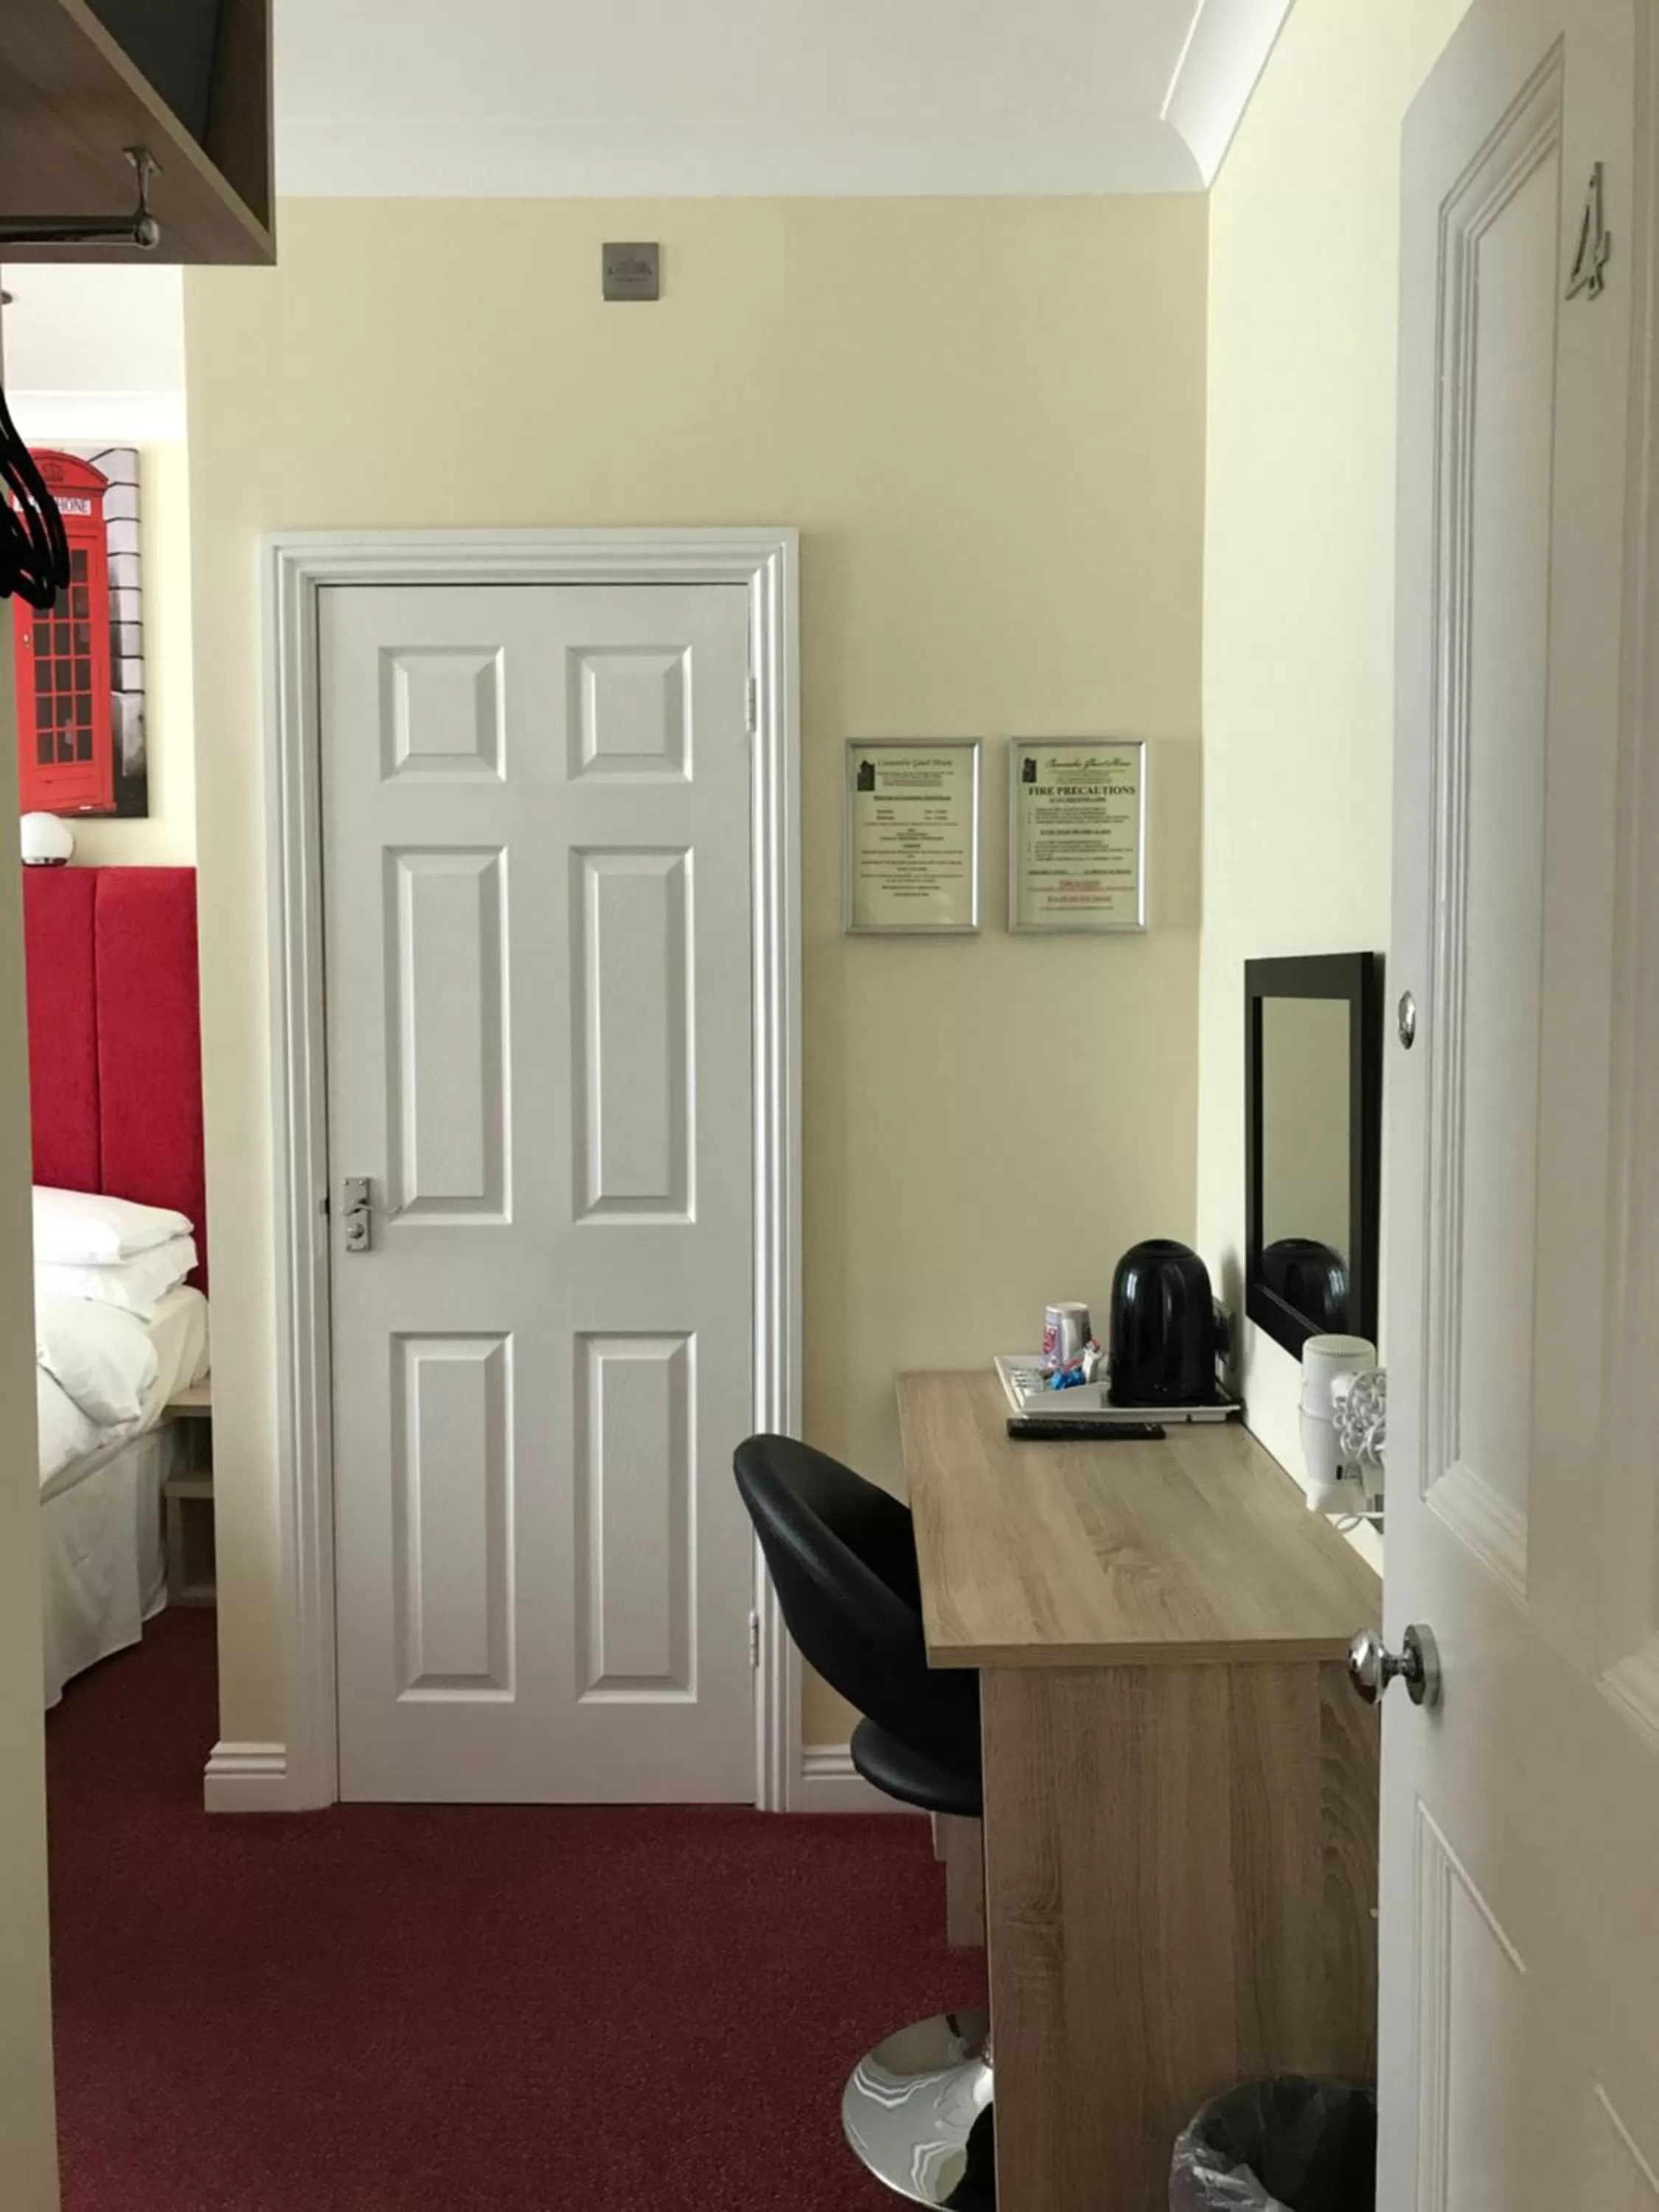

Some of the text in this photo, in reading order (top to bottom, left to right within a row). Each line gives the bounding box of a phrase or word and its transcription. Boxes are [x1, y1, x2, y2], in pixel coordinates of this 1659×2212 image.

[1564, 161, 1611, 301] 4
[1029, 786, 1136, 796] FIRE PRECAUTIONS
